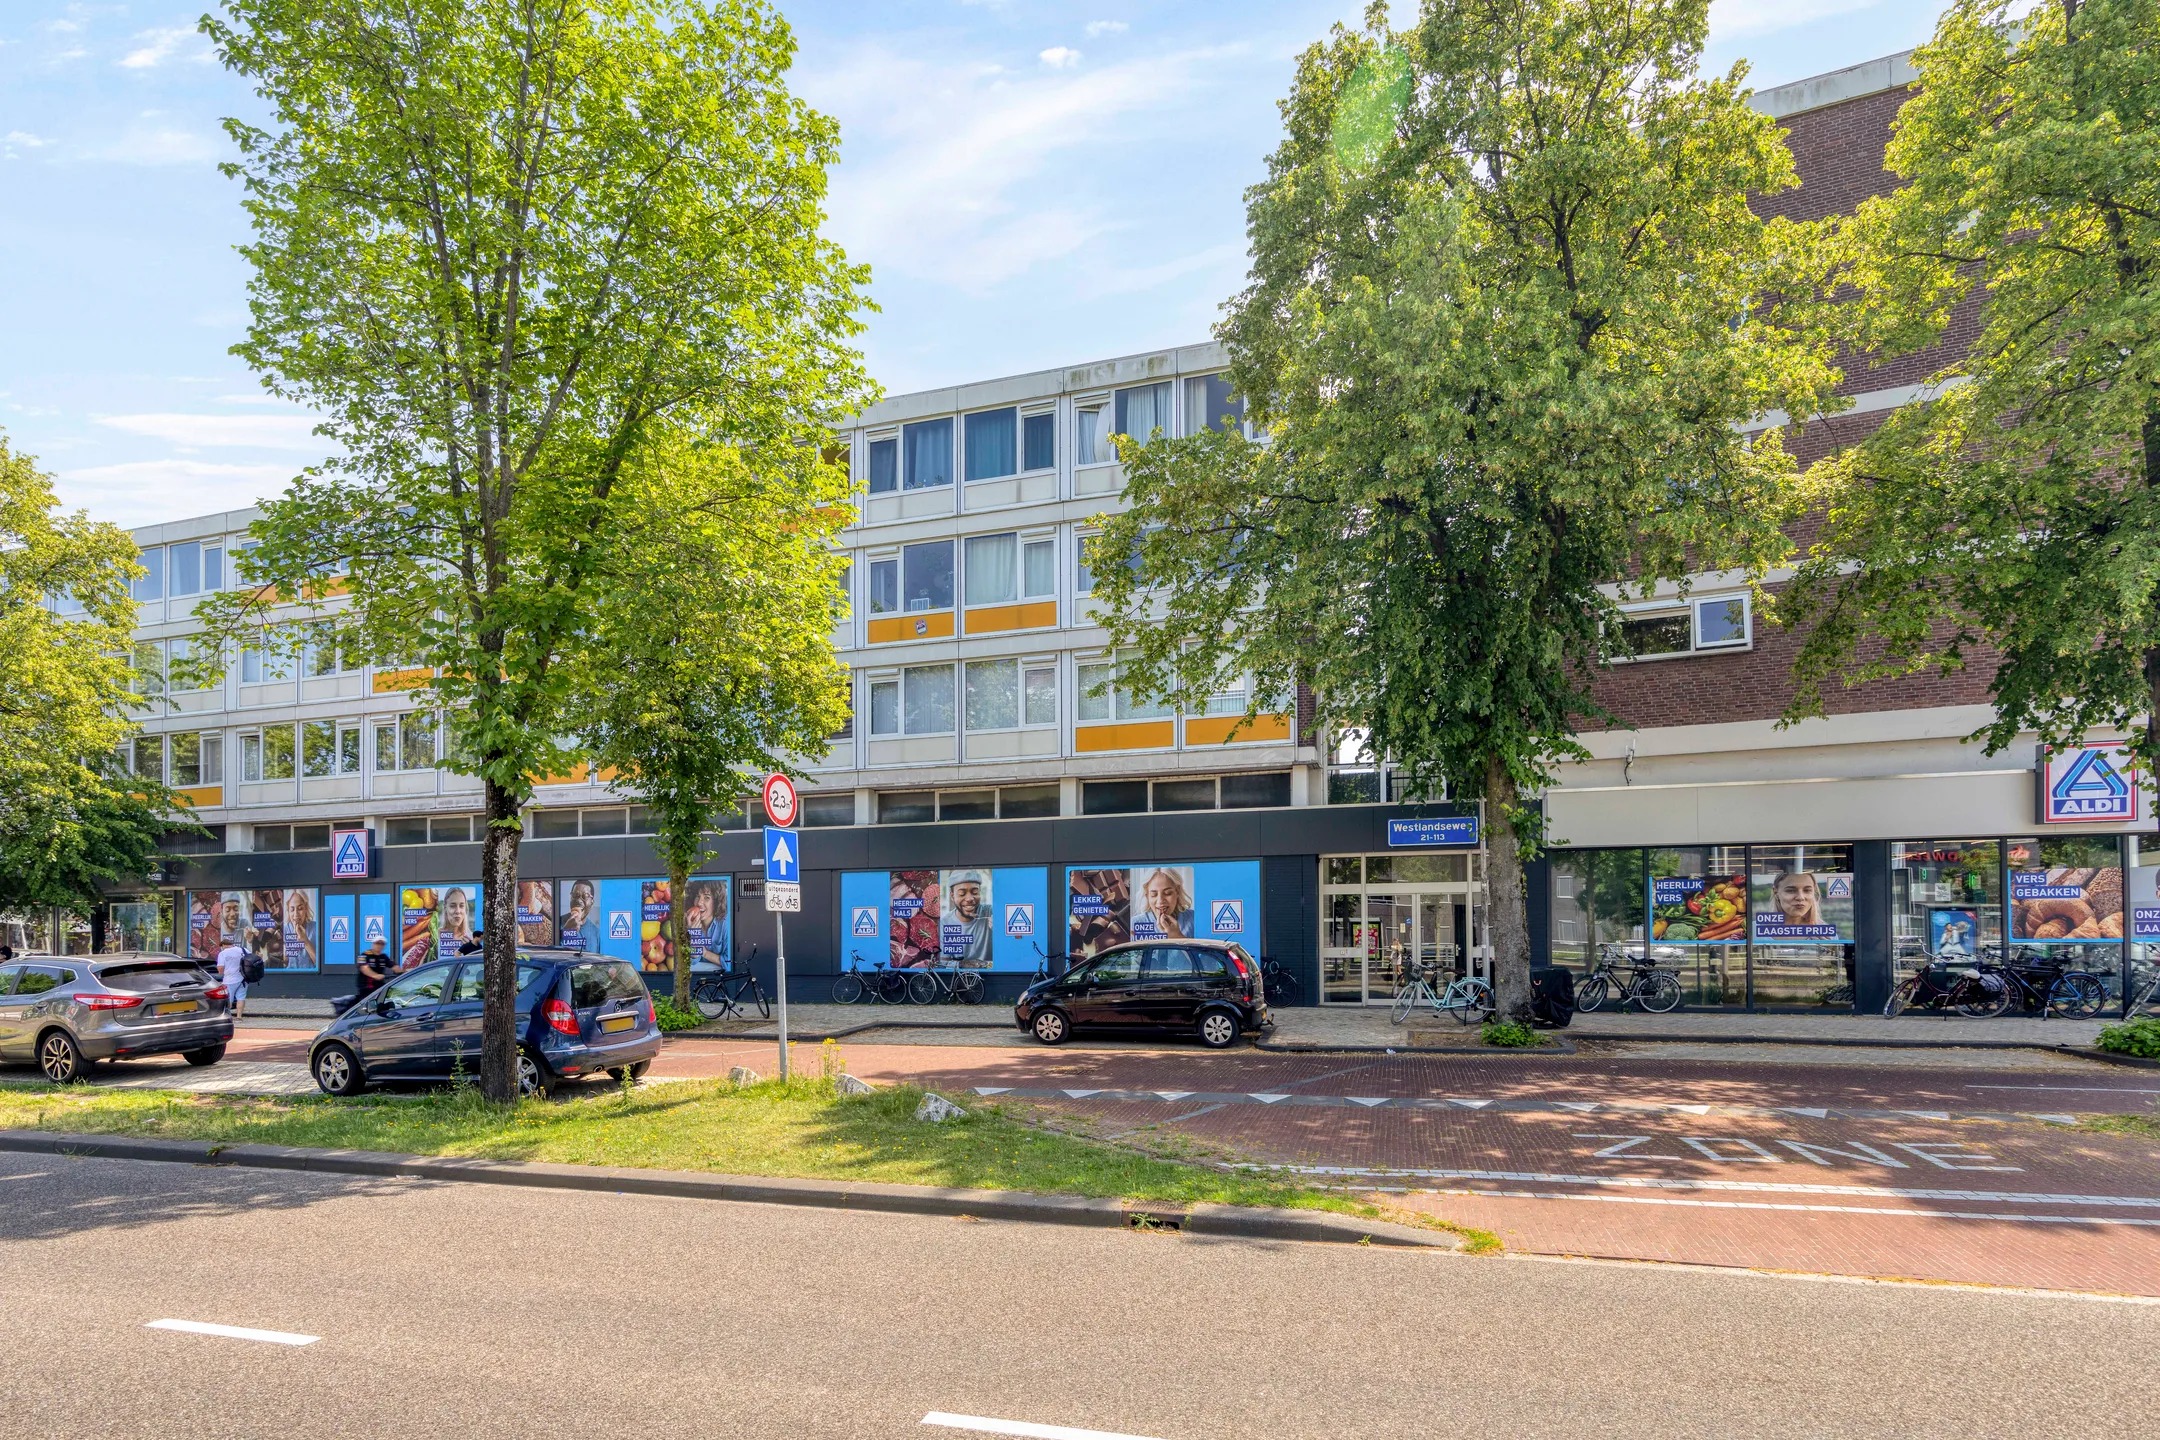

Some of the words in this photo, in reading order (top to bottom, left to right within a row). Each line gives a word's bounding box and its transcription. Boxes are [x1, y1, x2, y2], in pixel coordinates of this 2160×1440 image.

[2060, 798, 2121, 814] ALDI
[339, 864, 362, 873] ALDI
[2015, 874, 2045, 883] VERS
[1656, 881, 1702, 890] HEERLIJK
[2016, 887, 2079, 897] GEBAKKEN
[1656, 894, 1682, 902] VERS
[1757, 914, 1784, 922] ONZE
[1757, 926, 1803, 935] LAAGSTE
[1805, 926, 1835, 935] PRIJS
[944, 946, 963, 954] PRIJS
[1571, 1133, 2027, 1173] ZONE
